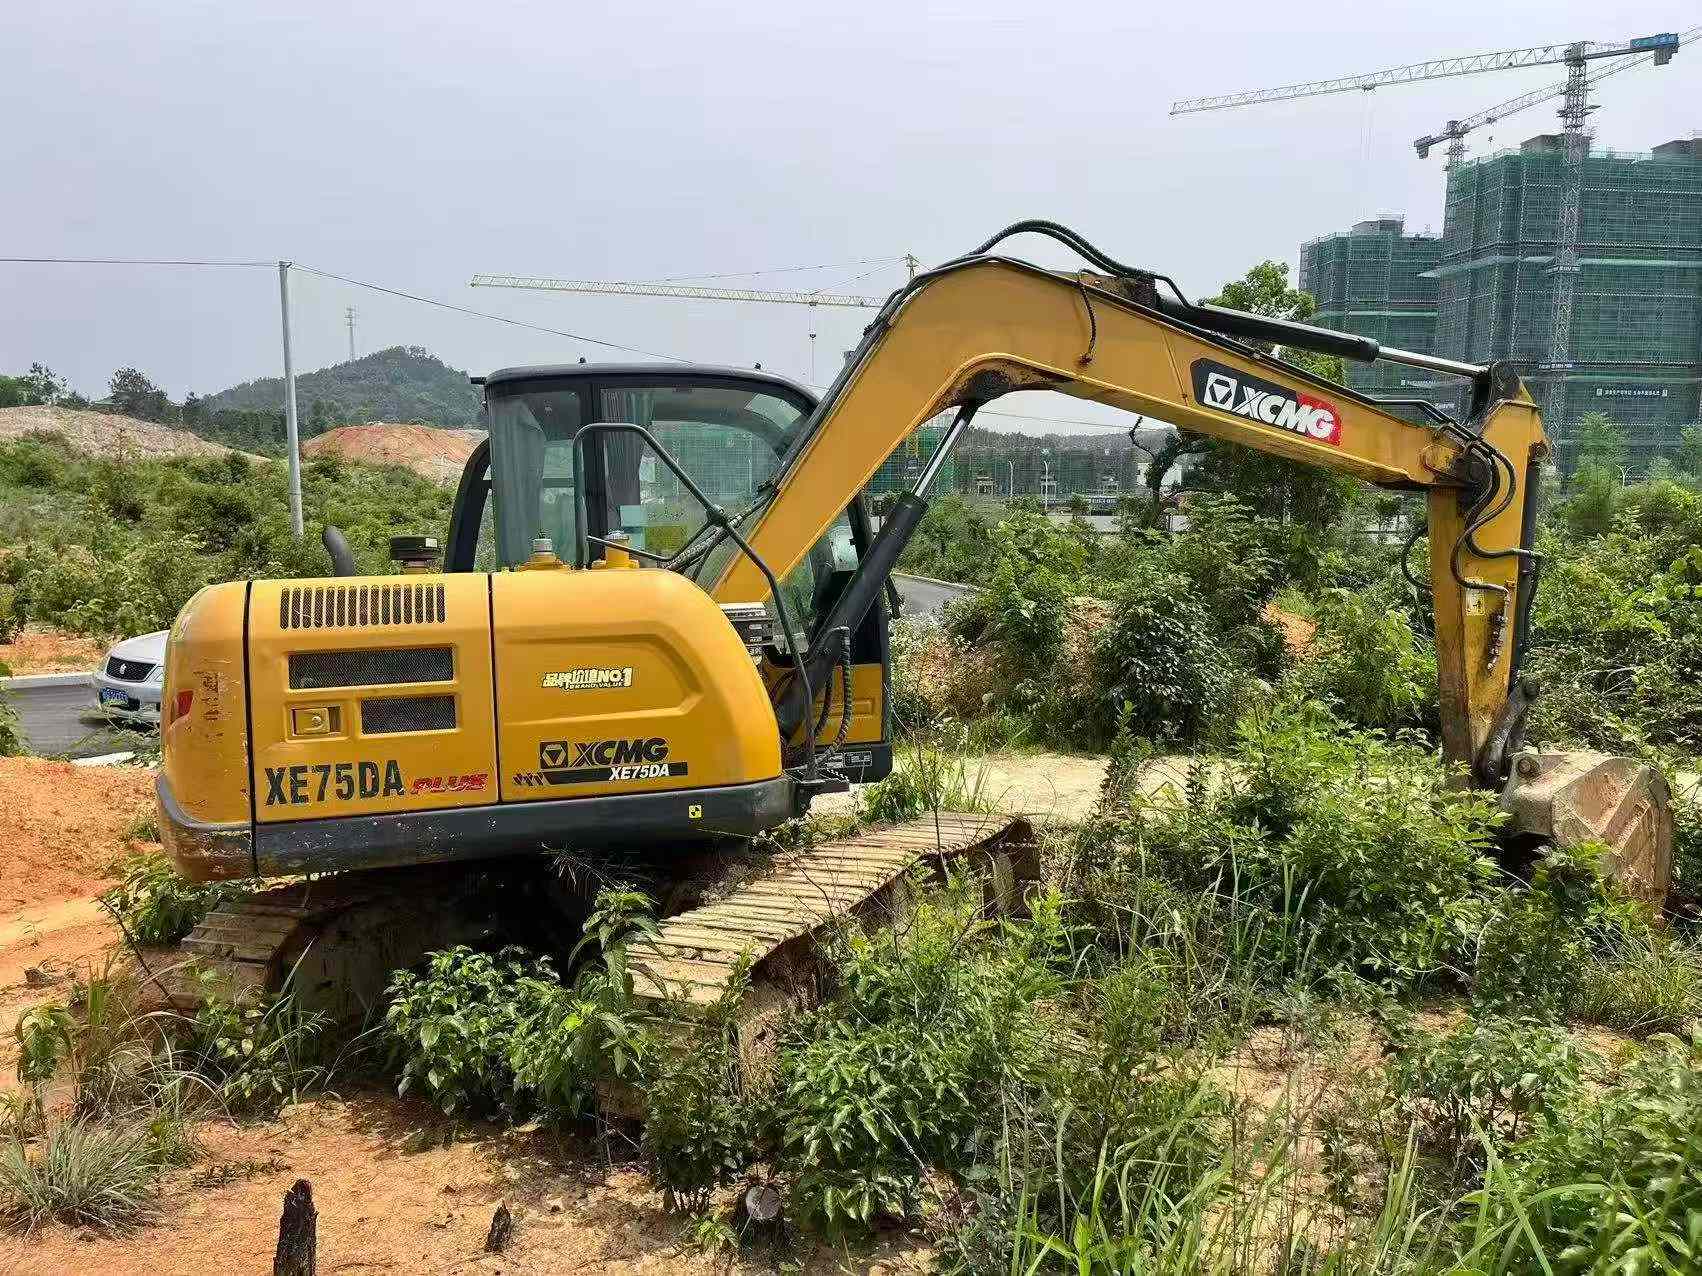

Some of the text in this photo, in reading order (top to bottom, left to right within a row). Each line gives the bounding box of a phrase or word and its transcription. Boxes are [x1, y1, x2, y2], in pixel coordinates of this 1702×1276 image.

[1231, 385, 1334, 439] XCMG
[569, 737, 669, 768] XCMG
[608, 763, 670, 781] XE75DA
[264, 759, 405, 806] XE75DA
